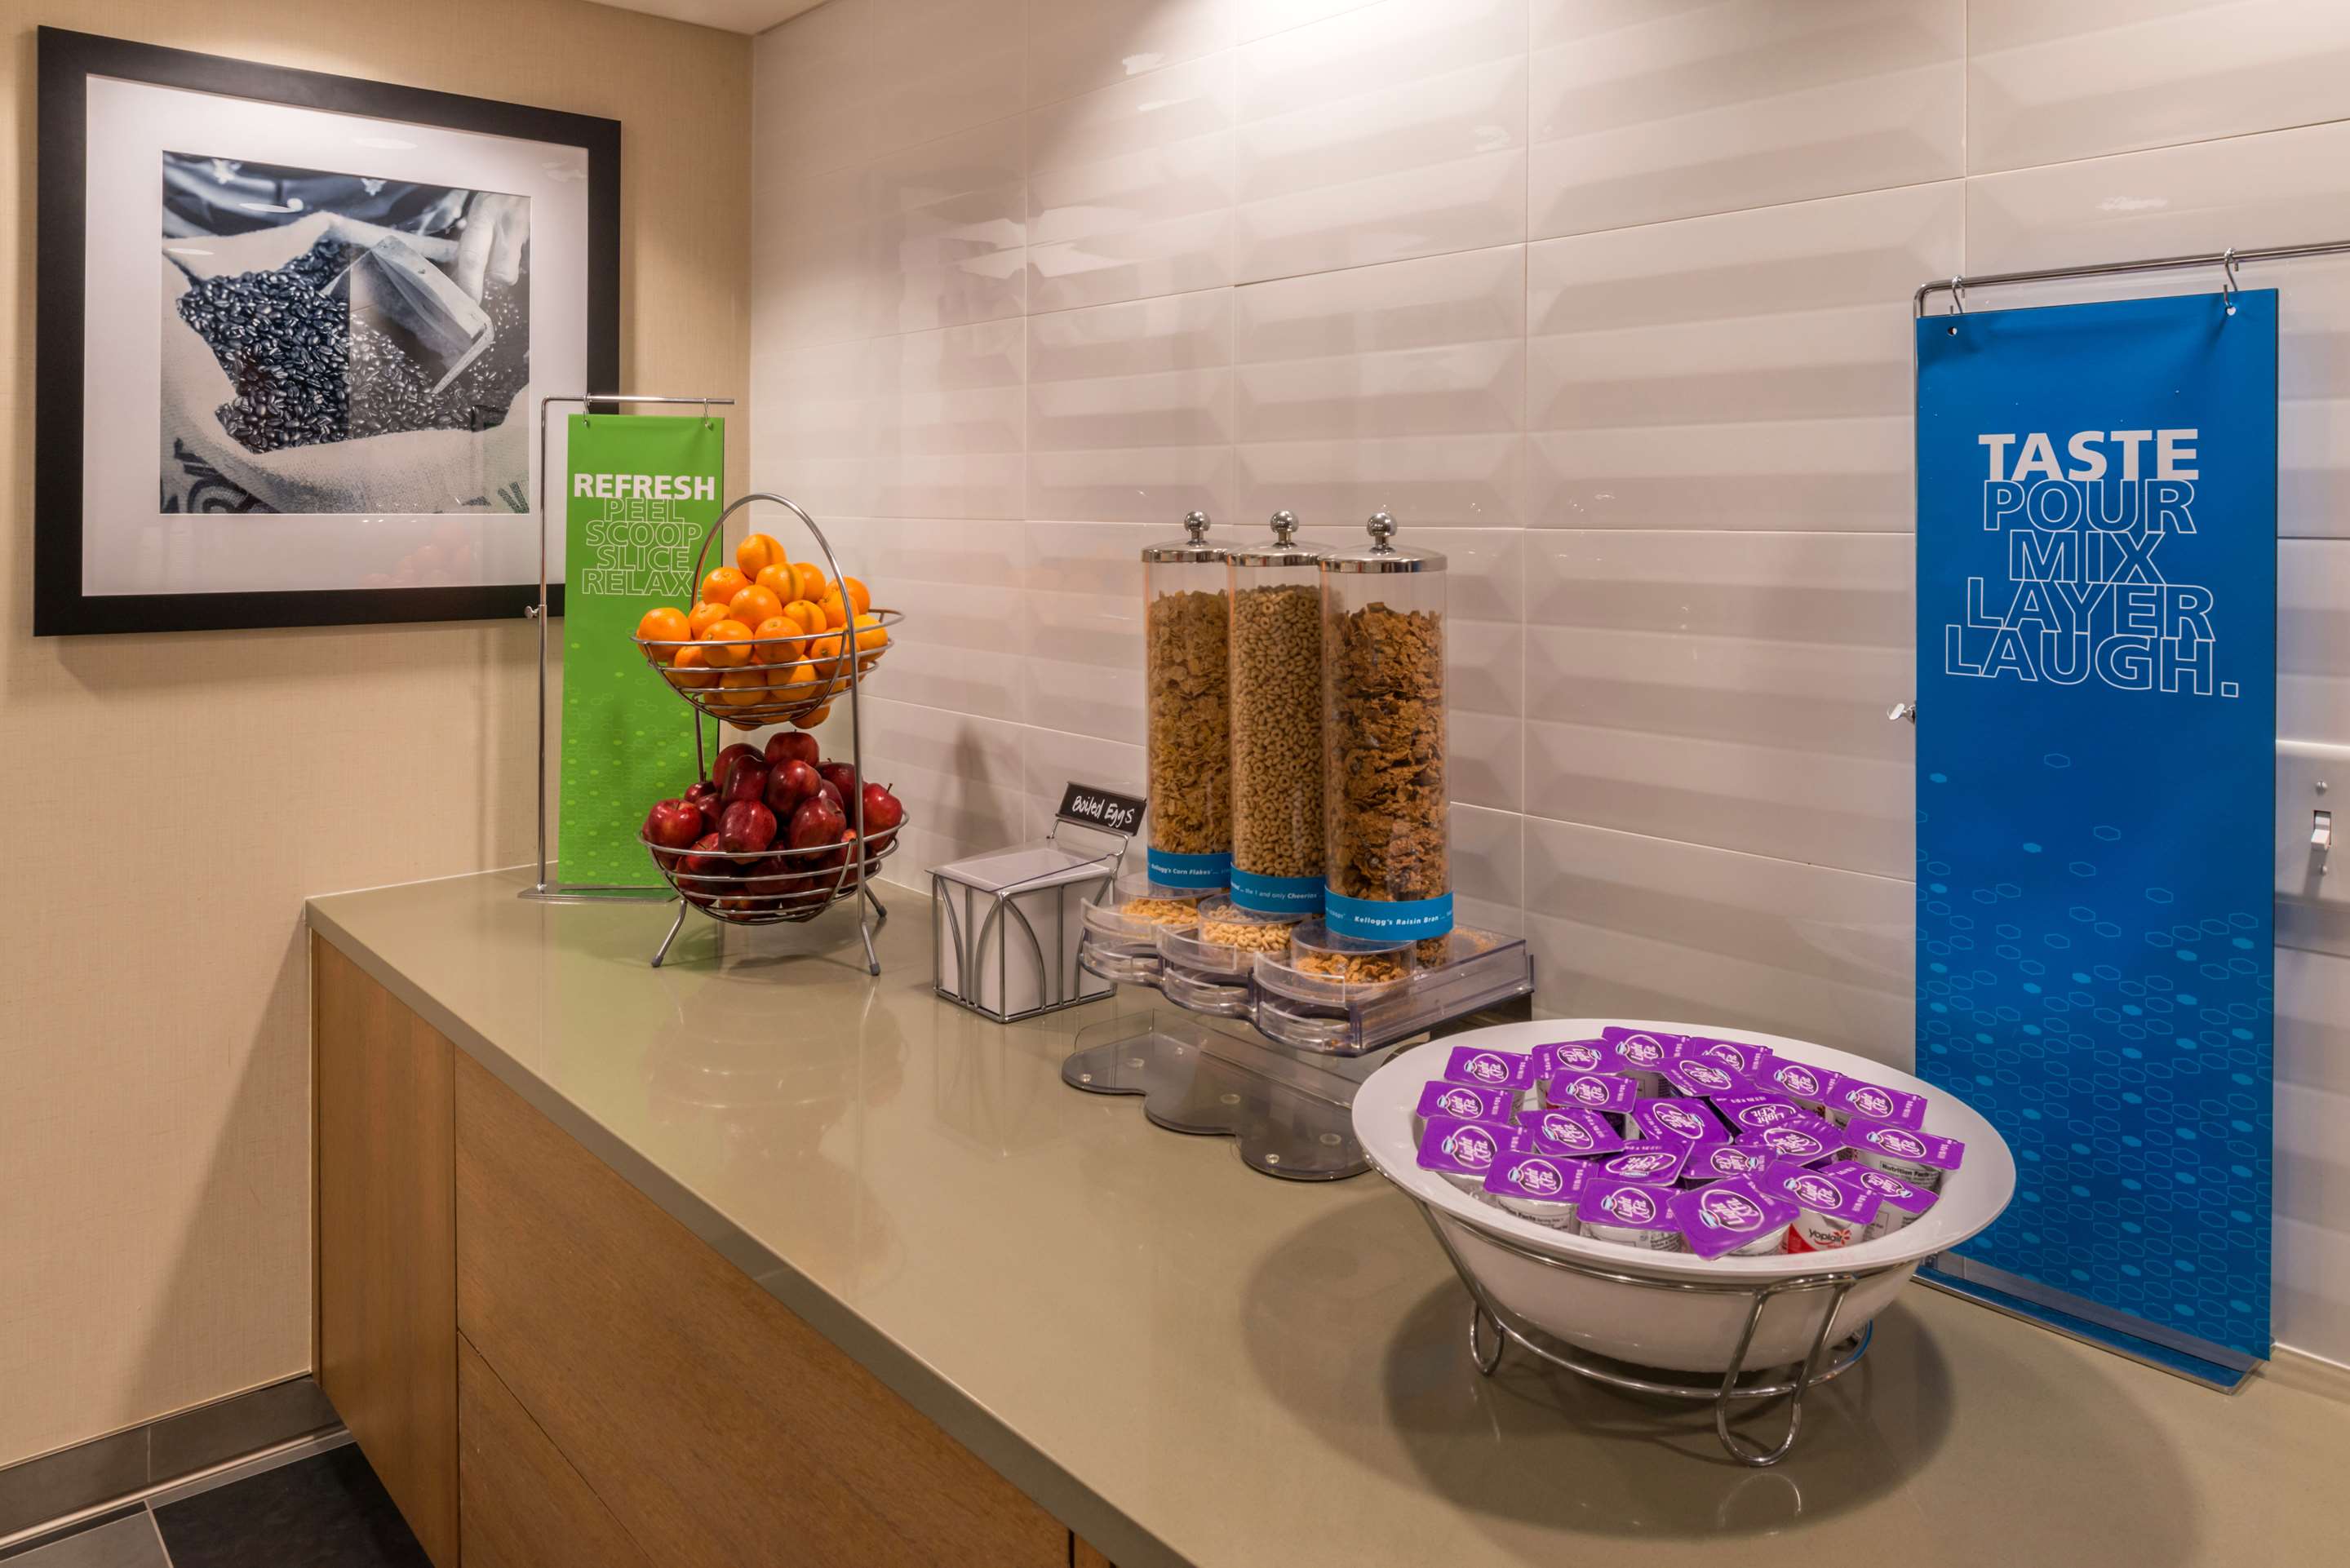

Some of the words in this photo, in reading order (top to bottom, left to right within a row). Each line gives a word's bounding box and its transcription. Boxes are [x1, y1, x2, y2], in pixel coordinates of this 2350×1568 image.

[1978, 428, 2199, 482] TASTE
[574, 473, 715, 500] REFRESH
[604, 497, 685, 524] PEEL
[1984, 478, 2197, 534] POUR
[586, 520, 703, 547] SCOOP
[596, 545, 690, 573] SLICE
[2010, 529, 2166, 585] MIX
[1967, 577, 2216, 642] LAYER
[1945, 624, 2239, 698] LAUGH.
[1071, 795, 1106, 819] Boiled
[1354, 915, 1393, 927] Kellogg's
[1396, 918, 1421, 926] Raisin
[1423, 915, 1439, 924] Bran
[1882, 1163, 1913, 1176] Nutrition
